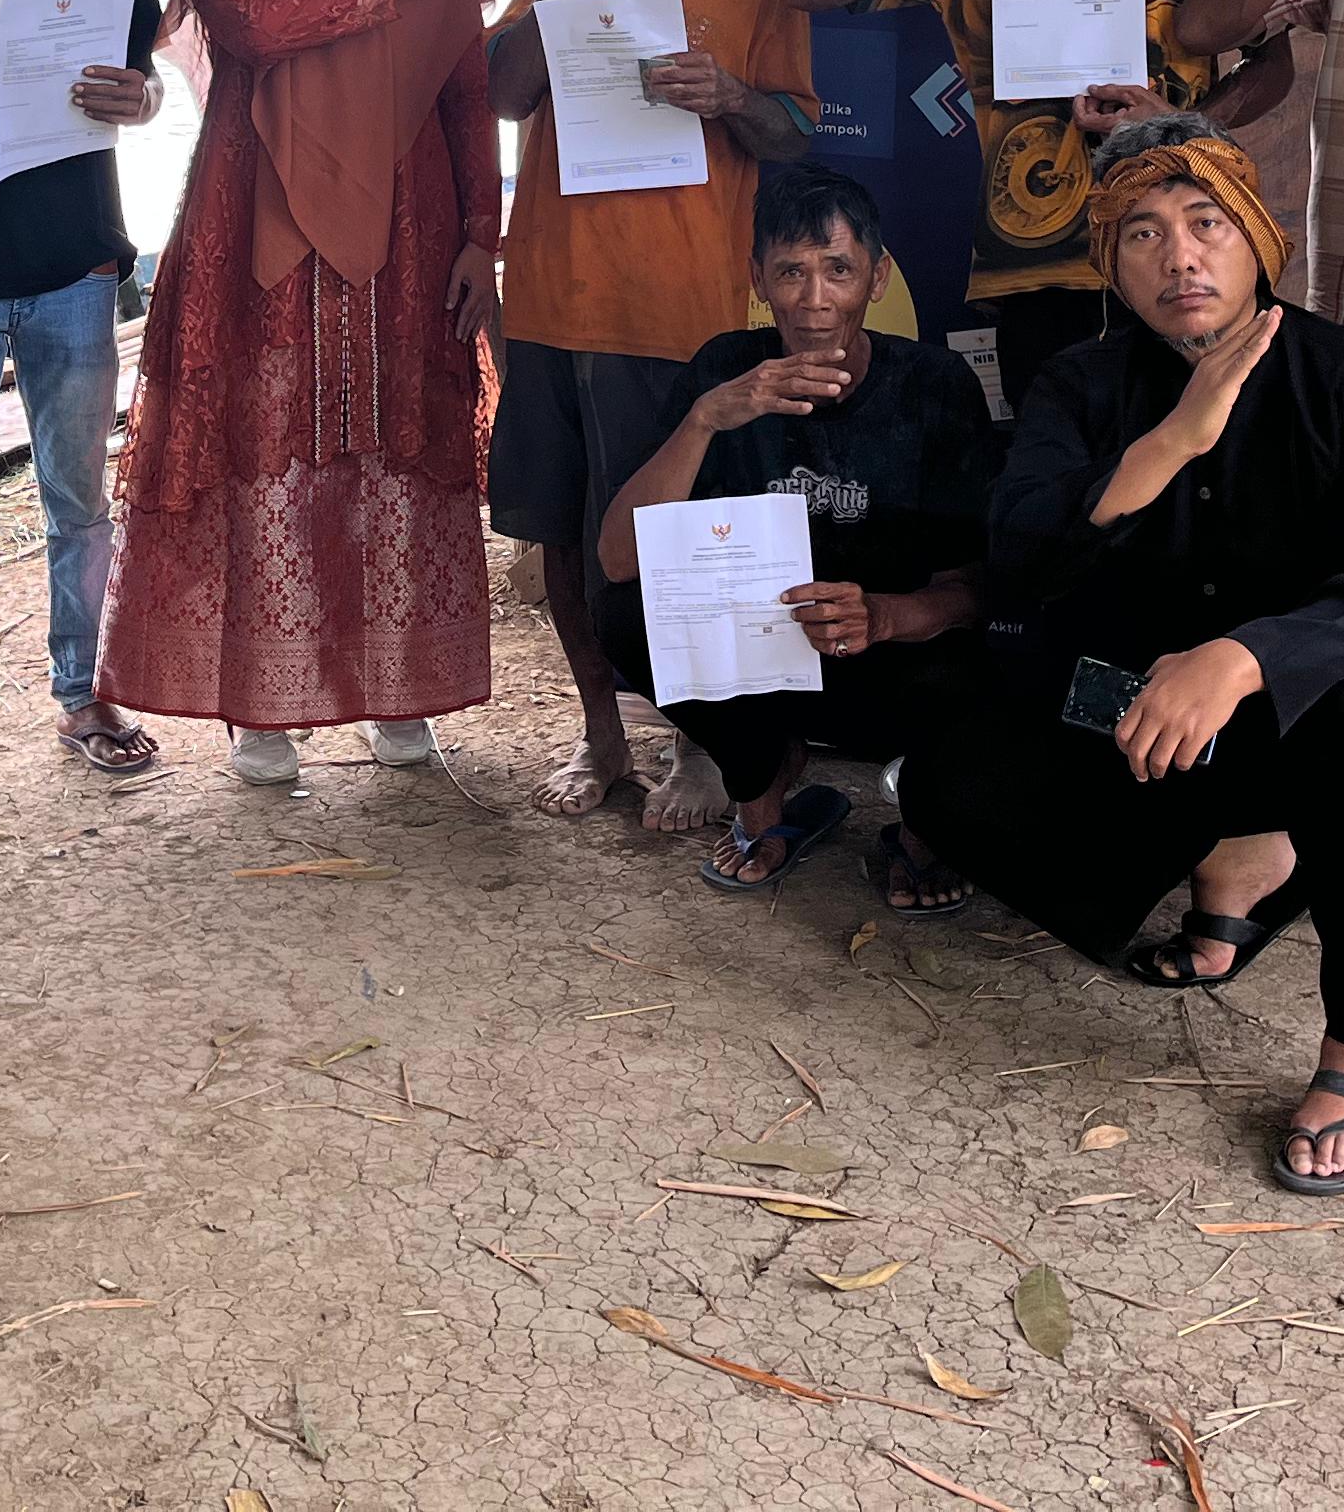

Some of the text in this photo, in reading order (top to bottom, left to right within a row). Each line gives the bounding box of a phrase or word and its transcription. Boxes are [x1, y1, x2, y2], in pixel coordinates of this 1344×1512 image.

[820, 102, 852, 116] (Jika
[815, 124, 867, 138] ompok)
[973, 353, 995, 364] NIB
[988, 621, 1025, 634] Aktif
